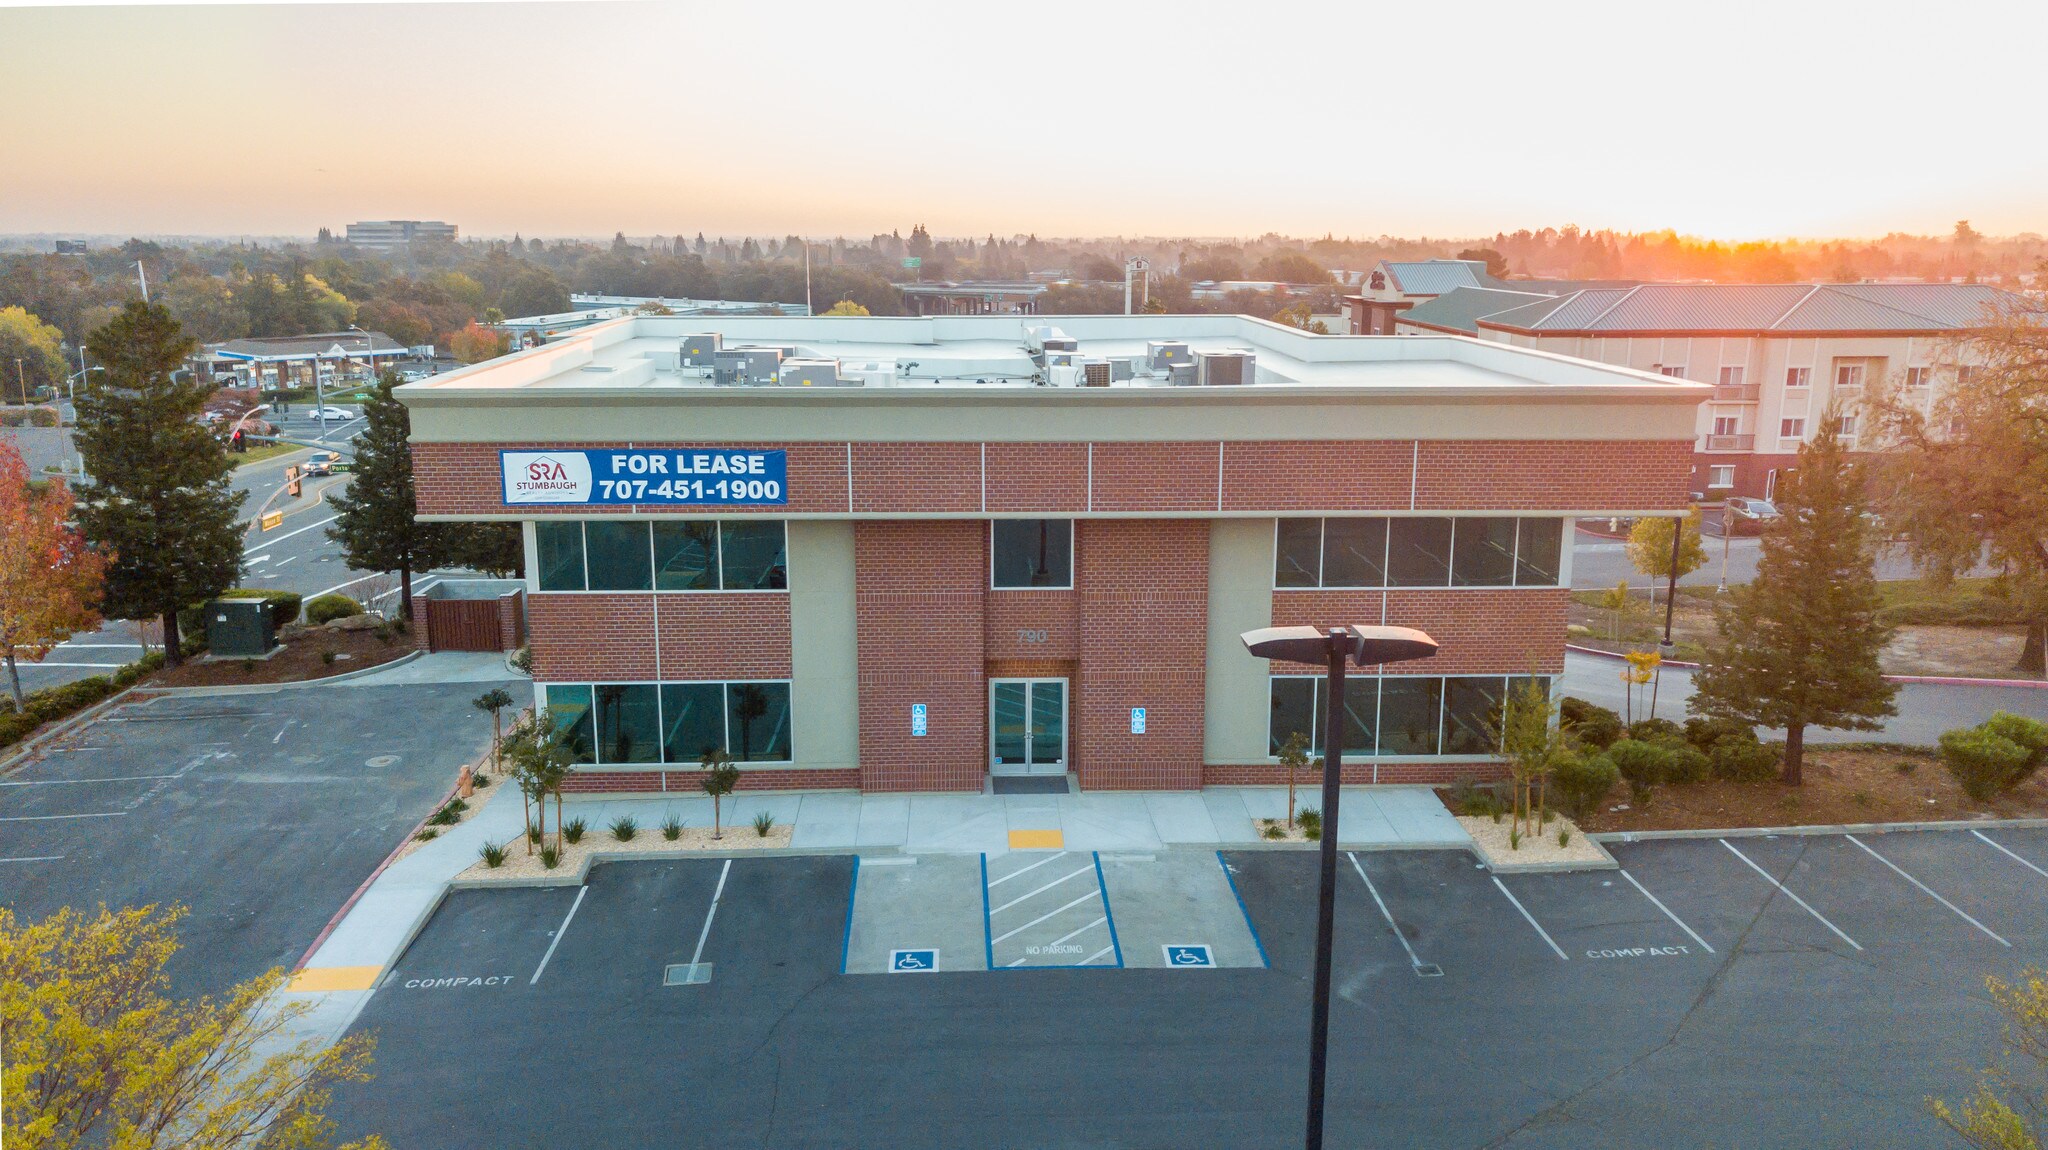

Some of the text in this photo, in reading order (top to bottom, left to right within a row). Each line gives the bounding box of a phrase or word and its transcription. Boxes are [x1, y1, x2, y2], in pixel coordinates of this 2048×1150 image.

[612, 454, 766, 474] FOR LEASE
[529, 463, 568, 480] SRA
[516, 481, 577, 490] STUMBAUGH
[598, 479, 780, 499] 707-451-1900
[1016, 629, 1048, 644] 790
[1025, 944, 1083, 955] NO PARKING
[1585, 945, 1689, 958] COMPACT
[404, 975, 514, 989] COMPACT
